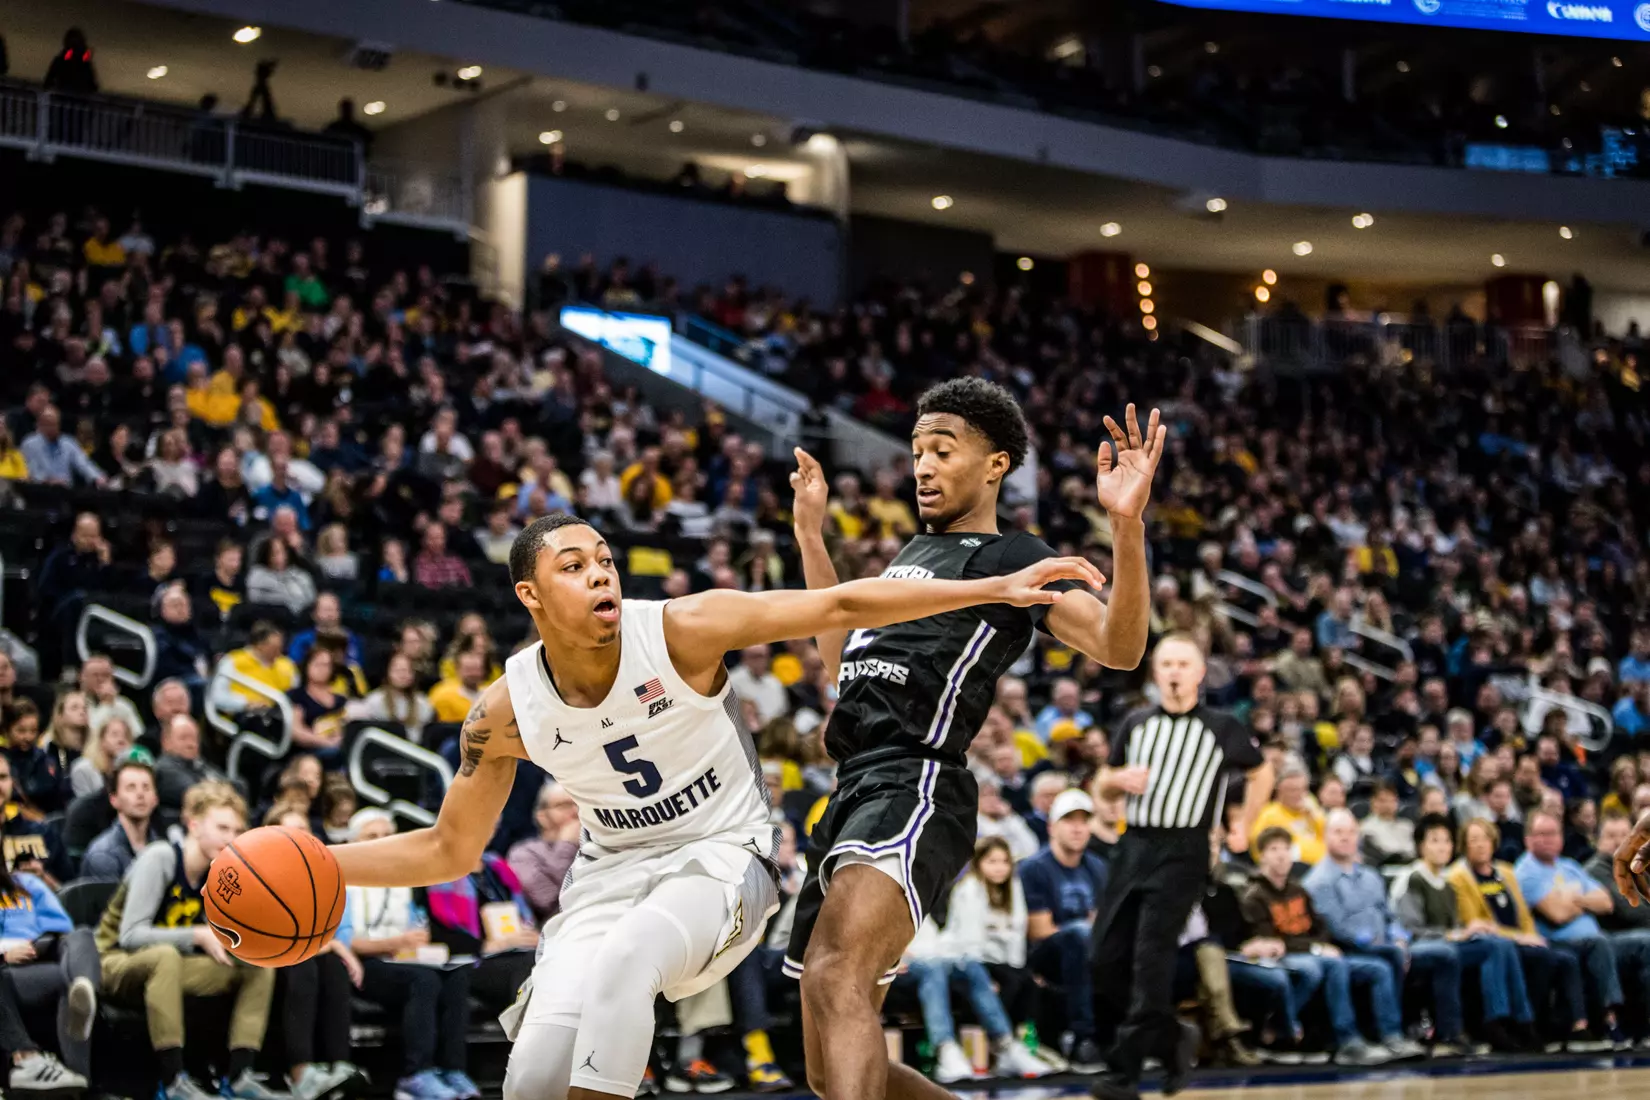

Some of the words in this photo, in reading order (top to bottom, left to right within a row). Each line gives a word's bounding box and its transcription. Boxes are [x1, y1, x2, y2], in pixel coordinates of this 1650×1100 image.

[600, 717, 614, 729] AL
[648, 699, 674, 717] EAST
[602, 734, 664, 799] 5
[593, 767, 722, 830] MARQUETTE
